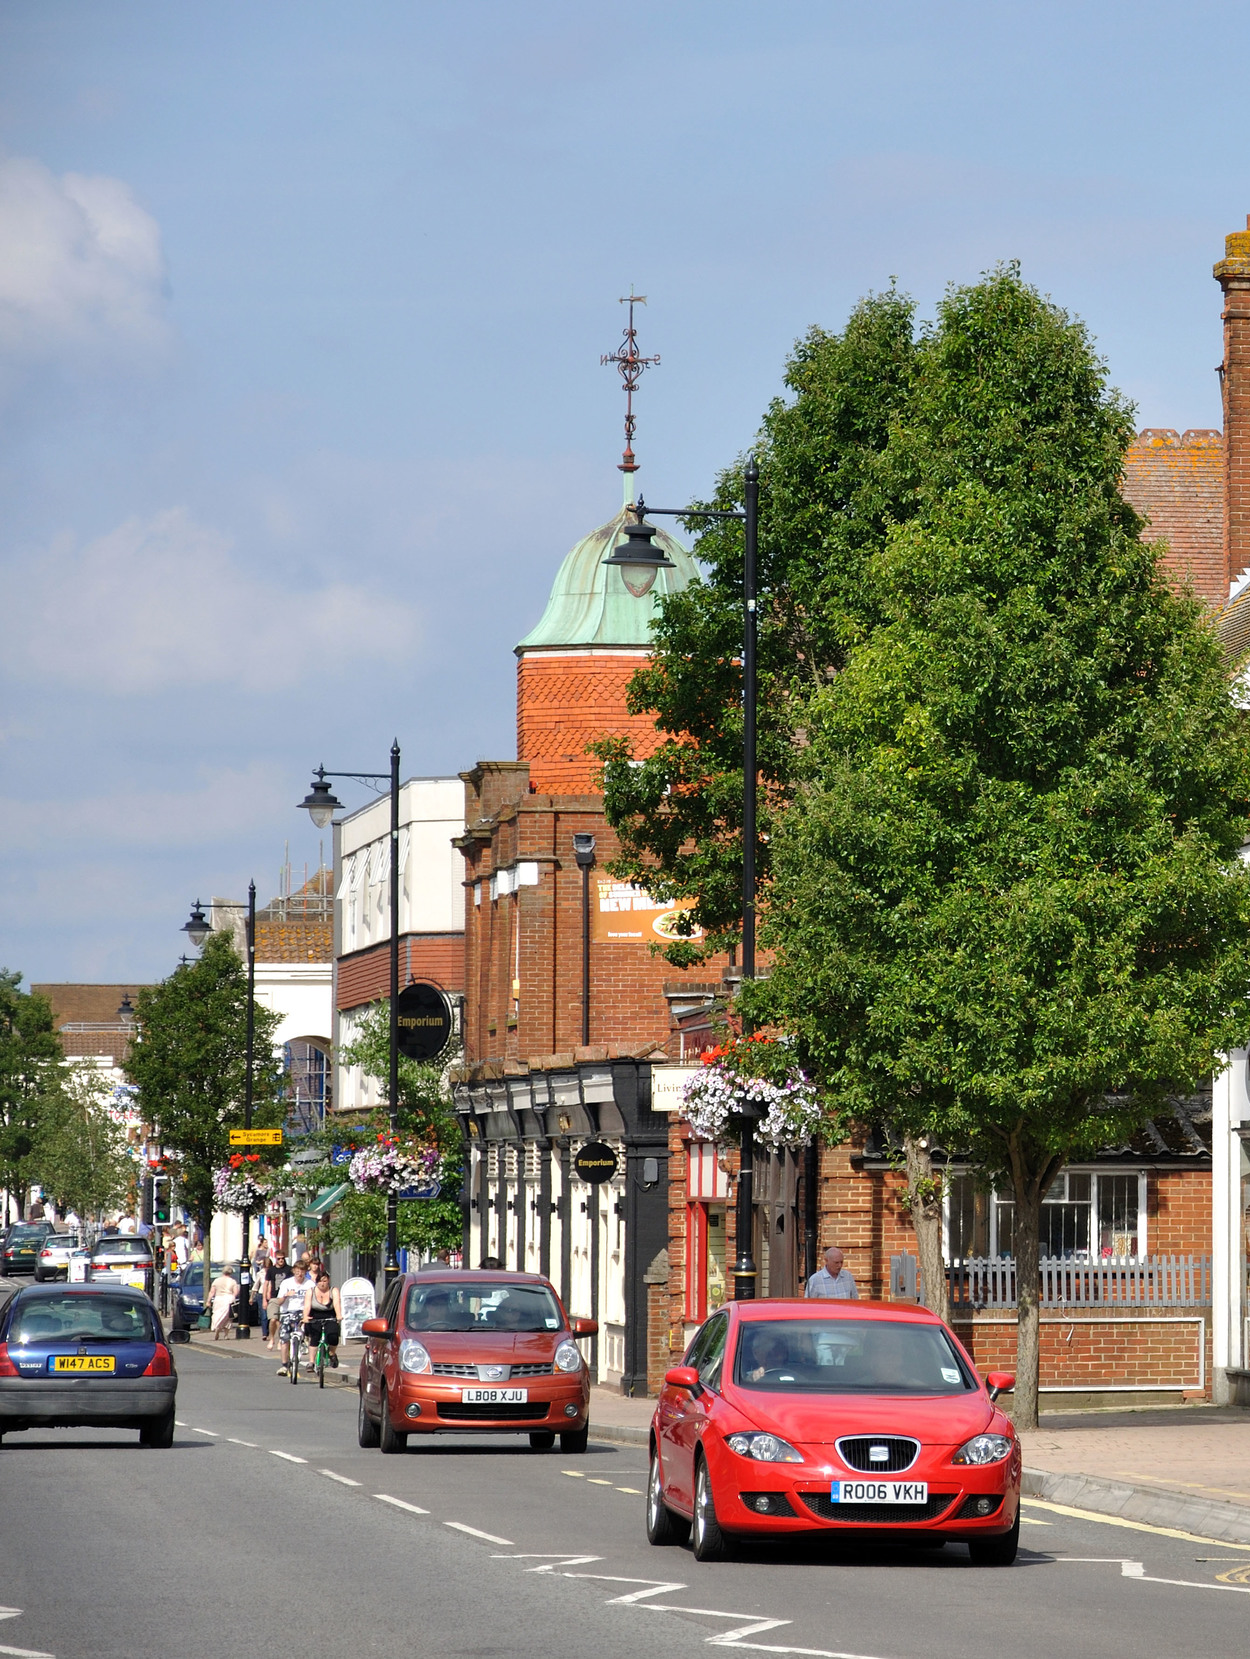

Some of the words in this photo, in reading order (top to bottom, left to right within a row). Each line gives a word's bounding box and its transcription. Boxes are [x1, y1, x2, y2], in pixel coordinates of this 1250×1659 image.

[599, 898, 632, 912] NEW
[397, 1016, 443, 1029] Emporium
[578, 1159, 614, 1168] Emporium
[59, 1358, 84, 1369] W147
[88, 1358, 110, 1369] ACS
[467, 1391, 497, 1401] LB08
[500, 1391, 522, 1401] XJU
[844, 1484, 887, 1500] RO06
[893, 1485, 925, 1500] VKH
